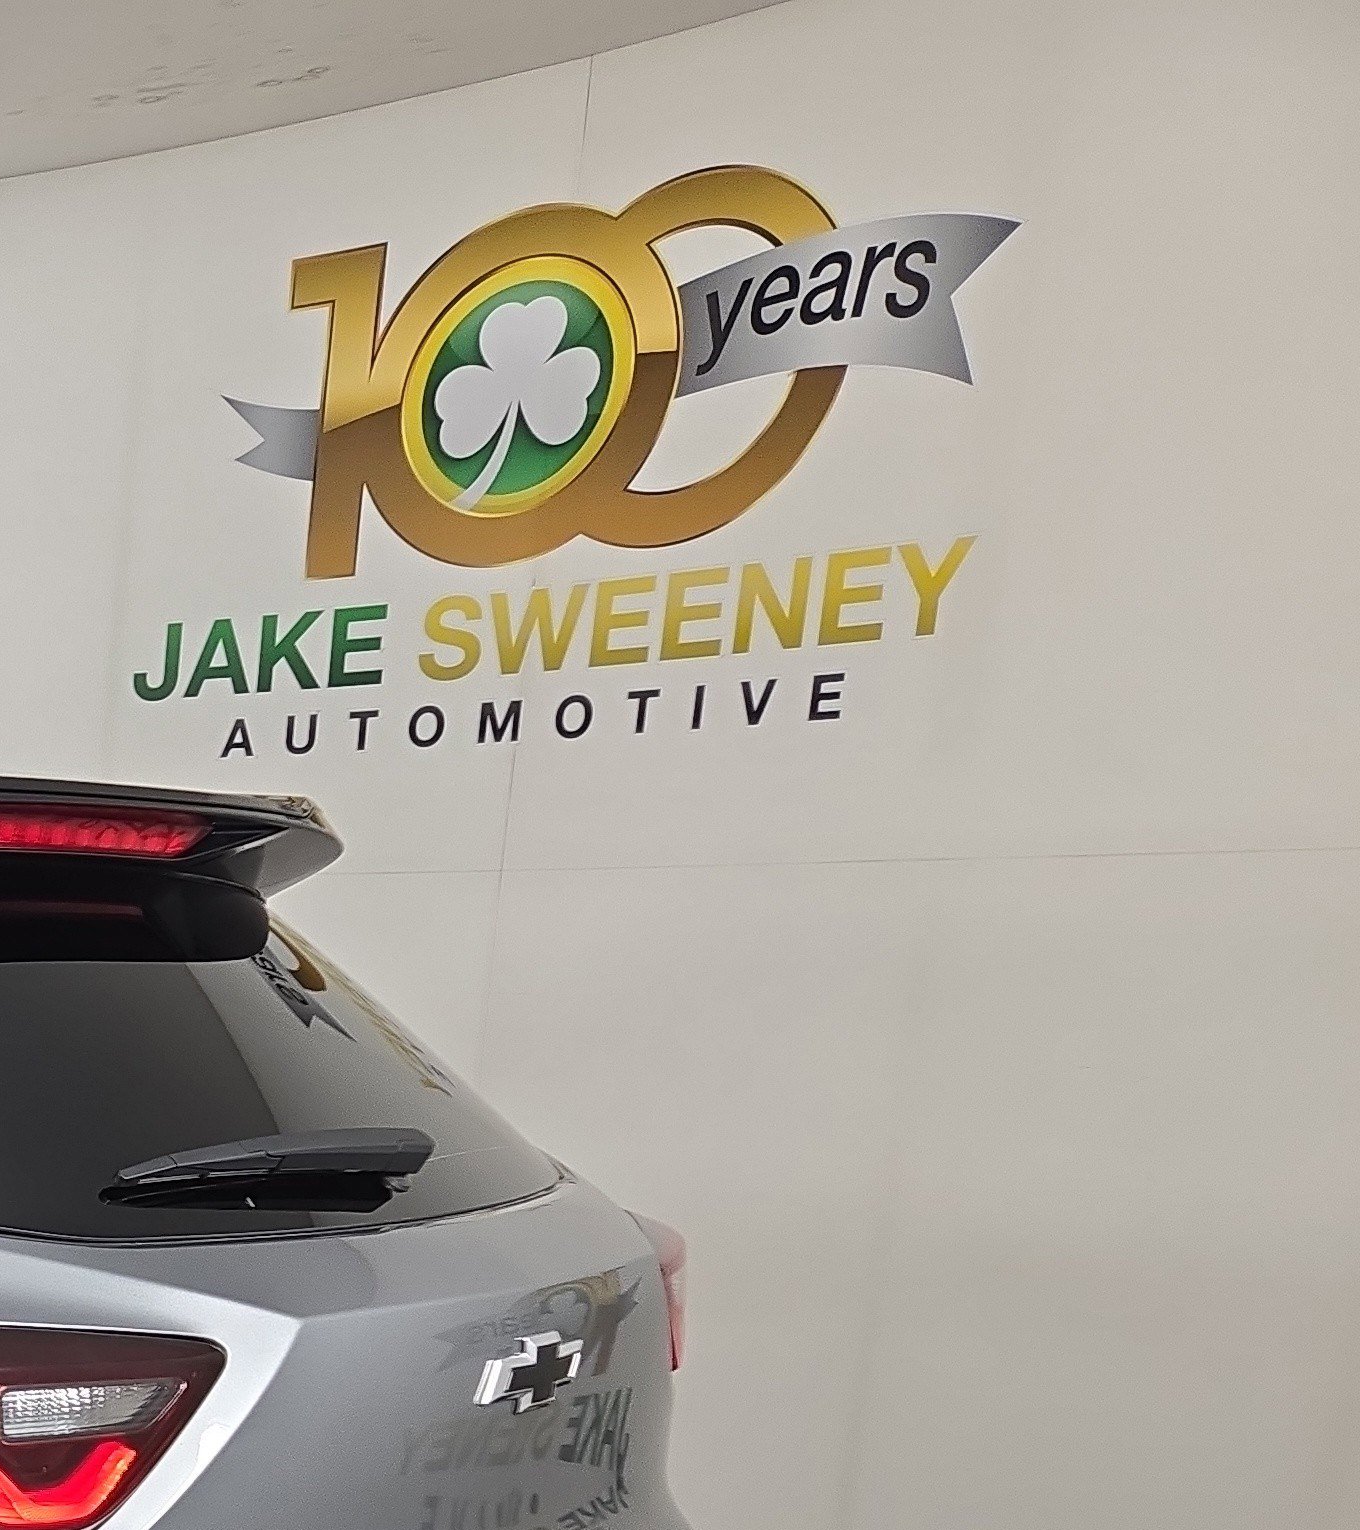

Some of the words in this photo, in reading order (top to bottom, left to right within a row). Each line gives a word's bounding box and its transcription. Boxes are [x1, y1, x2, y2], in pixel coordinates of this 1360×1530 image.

[696, 237, 937, 376] years
[133, 604, 388, 702] JAKE
[417, 534, 978, 681] SWEENEY
[221, 672, 846, 759] AUTOMOTIVE
